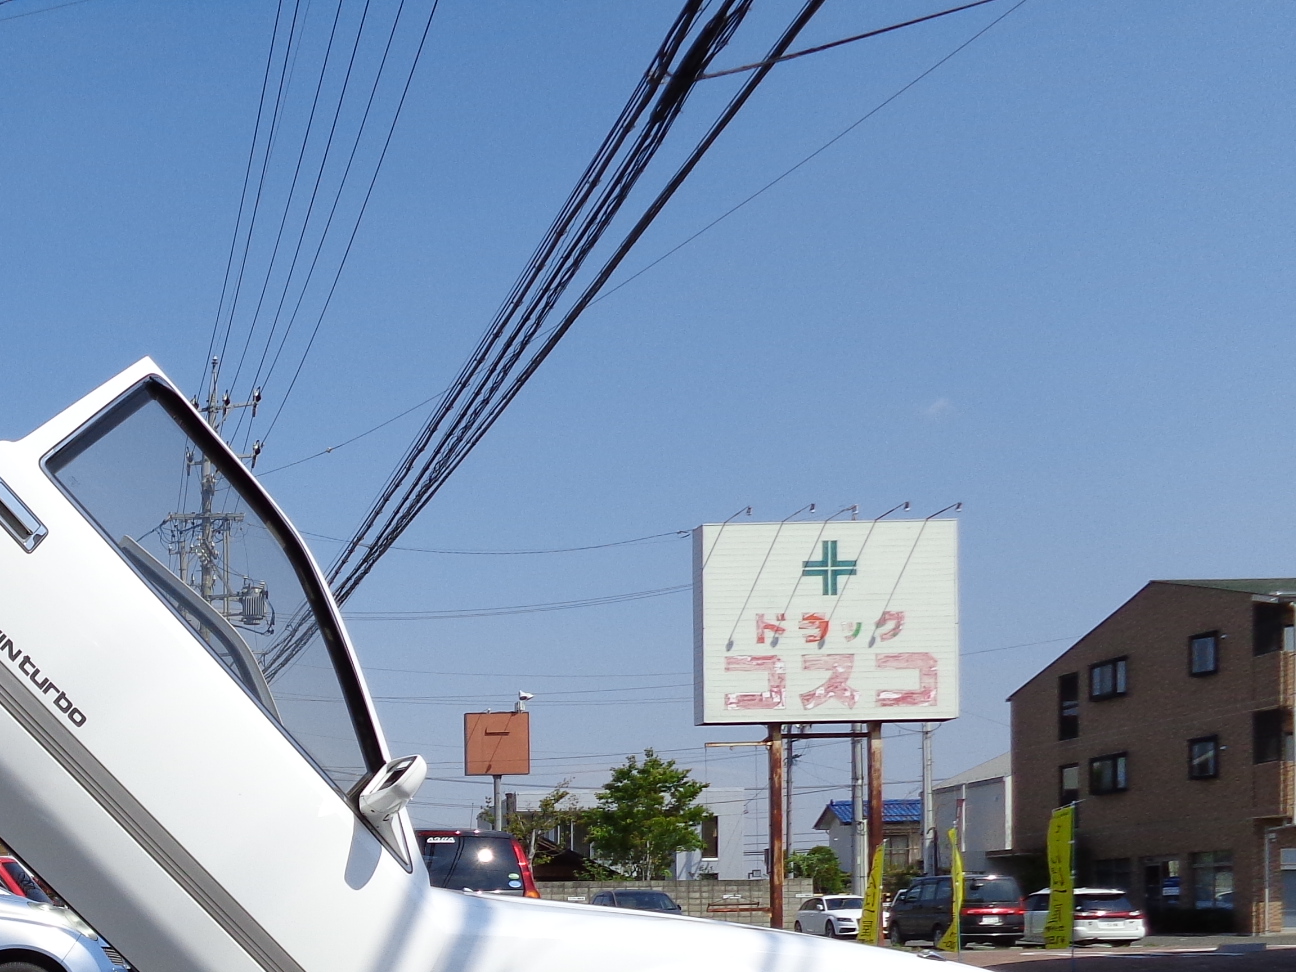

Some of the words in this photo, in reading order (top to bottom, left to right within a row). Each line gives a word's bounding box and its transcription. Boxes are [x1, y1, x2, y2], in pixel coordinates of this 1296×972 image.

[18, 655, 87, 728] turbo
[724, 652, 939, 710] コスコ
